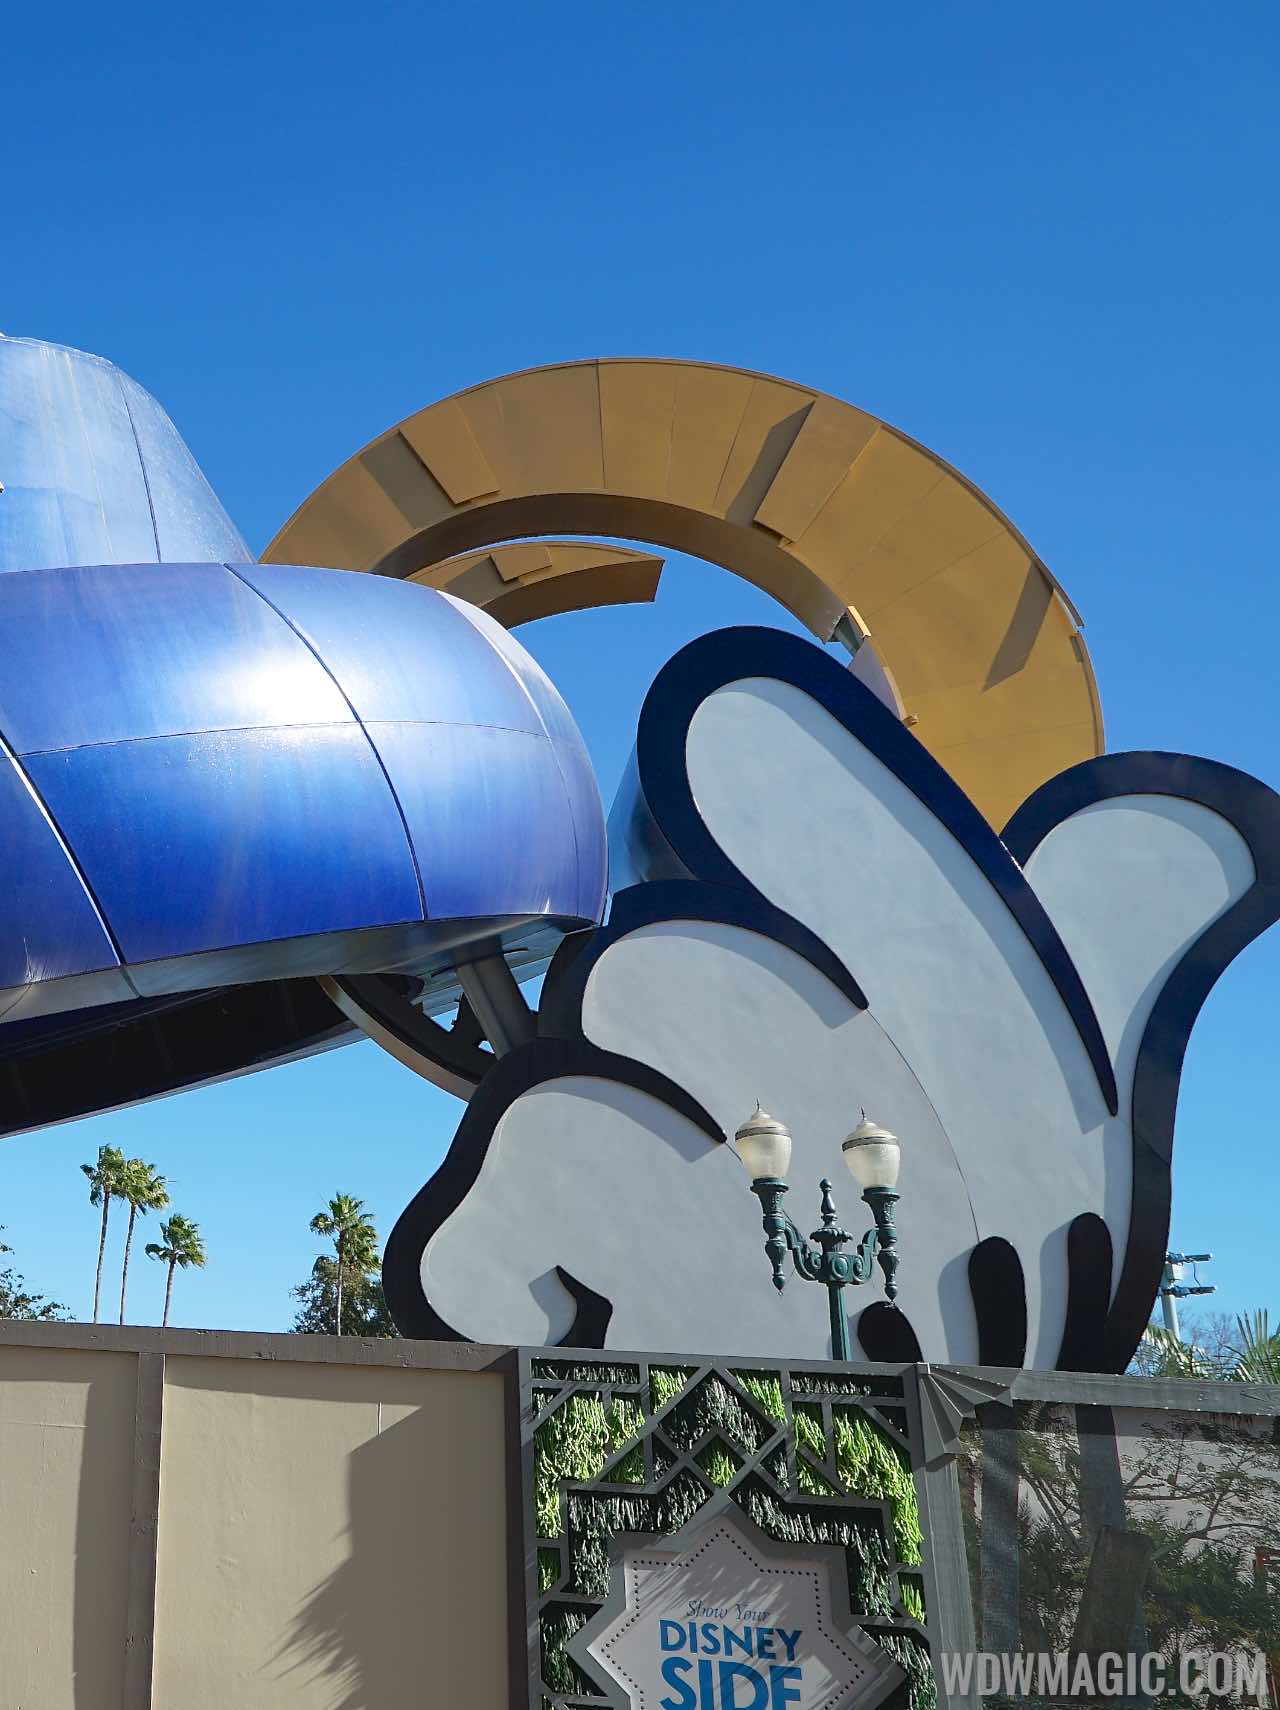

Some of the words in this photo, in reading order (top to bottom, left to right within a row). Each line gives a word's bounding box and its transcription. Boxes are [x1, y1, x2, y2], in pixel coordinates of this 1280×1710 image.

[687, 1600, 727, 1618] Show
[736, 1601, 770, 1621] Your
[659, 1619, 802, 1661] DISNEY
